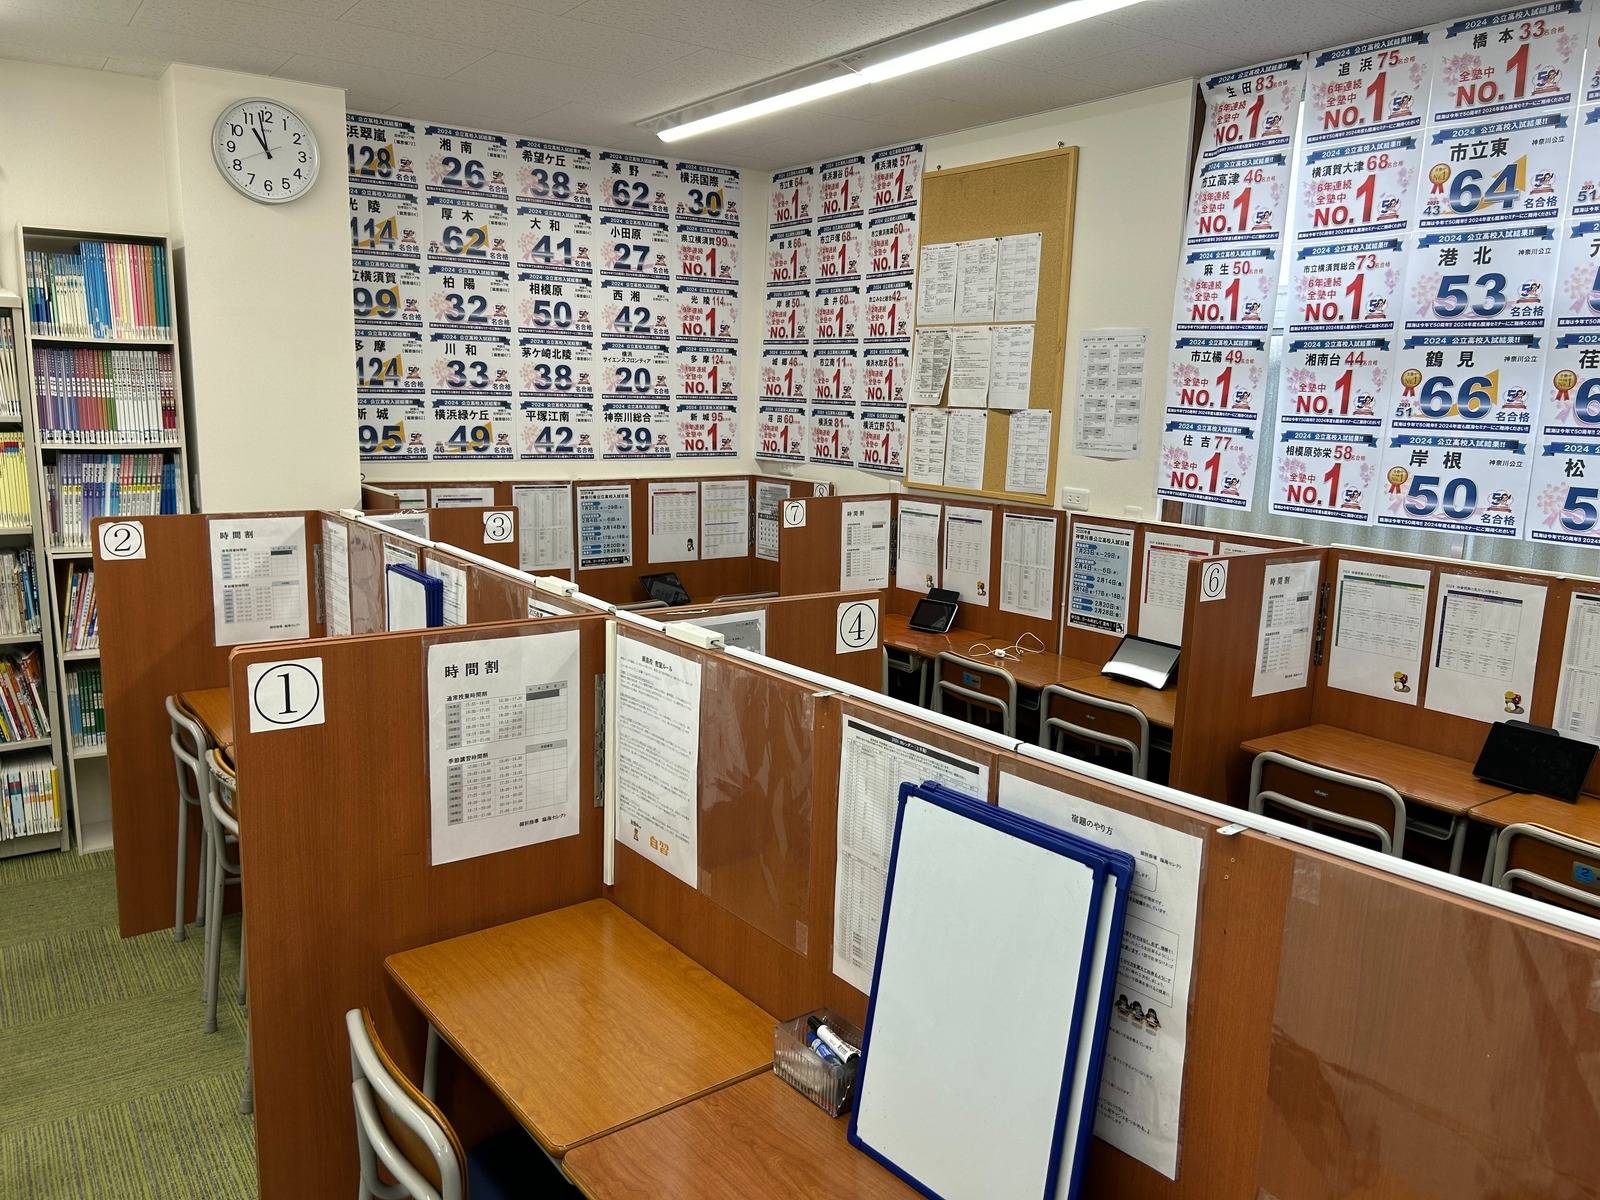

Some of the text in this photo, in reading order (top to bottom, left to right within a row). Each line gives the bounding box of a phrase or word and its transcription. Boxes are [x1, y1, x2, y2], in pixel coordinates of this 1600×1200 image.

[1473, 19, 1545, 49] 橋本 33
[1338, 50, 1399, 77] 追浜 75
[1456, 43, 1529, 107] NO.1
[1226, 75, 1274, 98] 生田 83
[1324, 72, 1386, 130] NO.1
[244, 112, 253, 125] 11
[260, 110, 273, 124] 12
[282, 119, 287, 131] 1
[1216, 95, 1264, 145] NO.1
[230, 124, 243, 137] 10
[293, 133, 302, 145] 2
[1452, 128, 1475, 137] 2024
[227, 141, 235, 152] 9
[440, 138, 472, 154] 湘南
[1451, 138, 1509, 161] 市立東
[233, 159, 242, 171] 8
[298, 151, 306, 163] 3
[347, 144, 393, 178] 128
[1312, 154, 1388, 178] 横須賀大津 68
[247, 173, 255, 184] 7
[293, 168, 302, 179] 4
[442, 157, 485, 189] 26
[611, 163, 639, 177] 秦野
[680, 172, 719, 187] 横浜国際
[1244, 169, 1263, 183] 46
[264, 180, 273, 191] 6
[282, 178, 290, 190] 5
[531, 168, 570, 199] 38
[1450, 164, 1520, 213] 64
[612, 180, 649, 209] 62
[688, 189, 721, 217] 30
[1313, 174, 1376, 227] NO.1
[1524, 196, 1557, 209] 名合格
[441, 208, 474, 222] 厚木
[1200, 187, 1251, 233] NO.1
[1423, 205, 1440, 216] 43
[351, 216, 395, 250] 114
[531, 218, 560, 231] 大和
[611, 226, 641, 240] 小田原
[443, 226, 487, 256] 62
[532, 235, 572, 265] 41
[716, 237, 727, 247] 99
[614, 244, 649, 271] 27
[1357, 254, 1376, 269] 73
[1438, 246, 1492, 266] 港北
[1518, 248, 1551, 256] 神奈川公立
[683, 248, 717, 277] NO.1
[1204, 261, 1250, 276] 麻生 50
[443, 276, 475, 290] 柏陽
[529, 283, 563, 297] 相模原
[353, 287, 397, 317] 99
[1192, 278, 1240, 321] NO.1
[1305, 274, 1364, 321] NO.1
[1432, 273, 1507, 318] 53
[445, 294, 487, 322] 32
[533, 300, 572, 328] 50
[1510, 306, 1543, 317] 名合格
[614, 306, 650, 333] 42
[445, 343, 477, 356] 川和
[1225, 350, 1242, 363] 49
[1305, 352, 1364, 366] 湘南台 44
[1425, 351, 1474, 368] 鶴見
[356, 357, 399, 386] 124
[447, 360, 489, 388] 33
[534, 364, 572, 391] 38
[615, 367, 651, 393] 20
[1181, 367, 1232, 408] NO.1
[1297, 370, 1353, 415] NO.1
[1420, 376, 1493, 419] 66
[526, 411, 570, 422] 平塚江南
[604, 413, 651, 423] 神奈川総合
[1396, 407, 1412, 417] 51
[1496, 412, 1530, 422] 名合格
[359, 425, 402, 453] 95
[448, 425, 490, 452] 49
[535, 426, 573, 453] 42
[616, 427, 651, 452] 39
[685, 423, 718, 451] NO.1
[1183, 435, 1232, 449] 住吉 77
[1334, 446, 1352, 460] 58
[1564, 445, 1589, 453] 2024
[1409, 450, 1462, 469] 岸根
[1489, 459, 1523, 467] 神奈川公立
[1565, 458, 1585, 478] 松
[1170, 452, 1221, 493] NO.1
[1288, 463, 1341, 507] NO.1
[1403, 475, 1478, 519] 50
[1481, 514, 1515, 526] 名合格
[219, 530, 254, 540] 時間割
[445, 660, 499, 679] 時間割
[1072, 814, 1112, 835] 宿題のやり方
